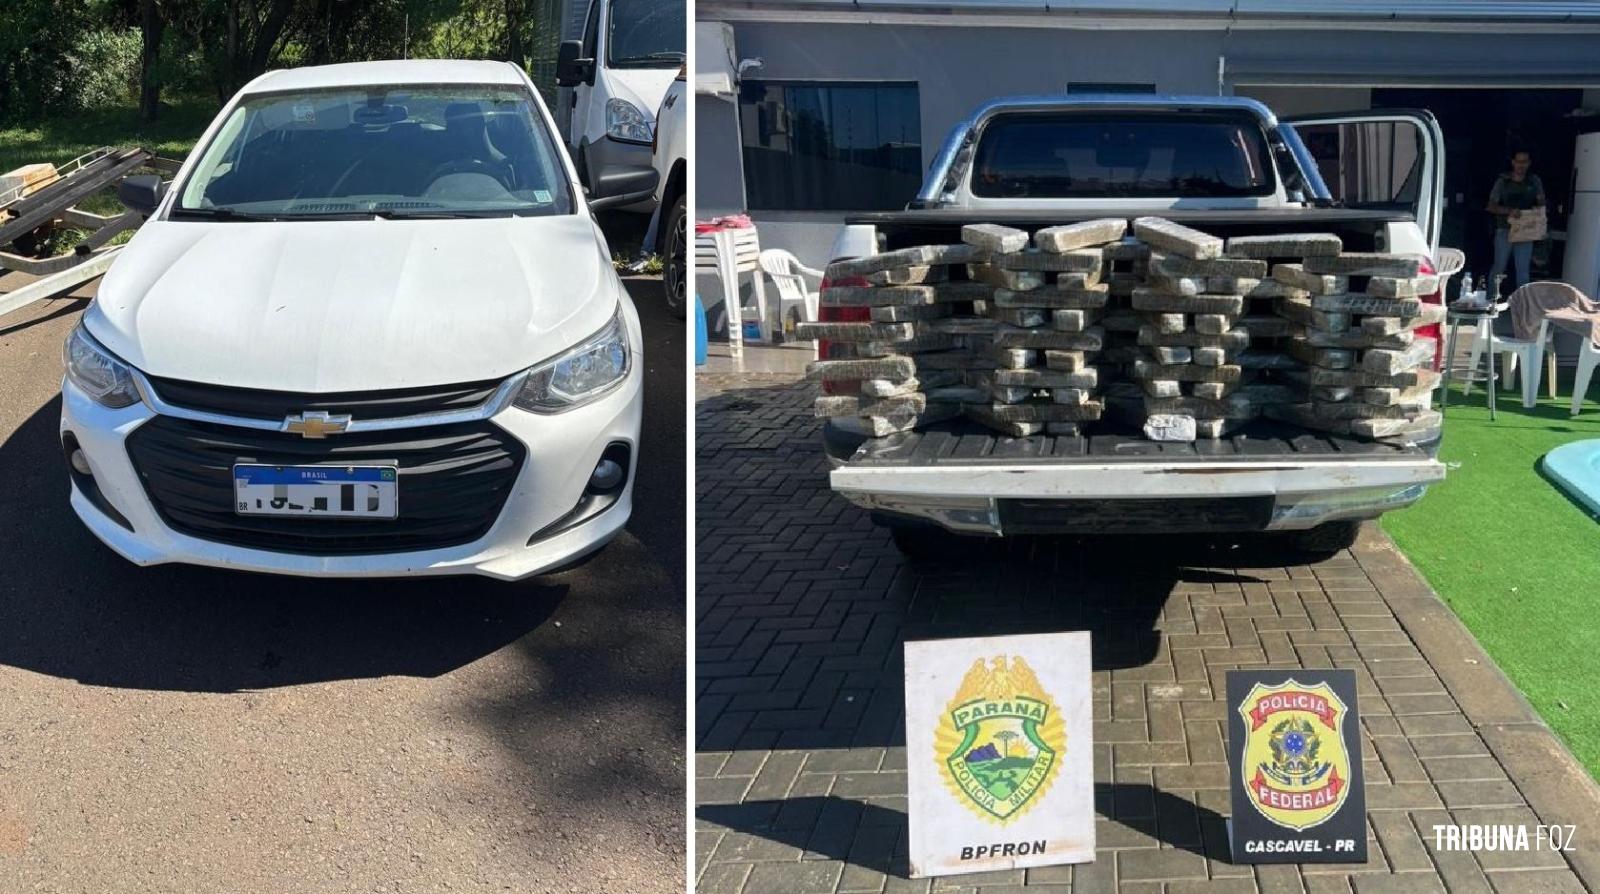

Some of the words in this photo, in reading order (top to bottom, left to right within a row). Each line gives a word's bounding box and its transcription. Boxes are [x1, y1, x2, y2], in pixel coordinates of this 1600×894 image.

[301, 471, 328, 479] BRASIL
[238, 502, 248, 511] BR
[957, 702, 1043, 724] PARANÁ
[1010, 756, 1049, 806] MILITAR
[1259, 789, 1335, 809] FEDERAL
[960, 840, 1047, 860] BPFRON
[1245, 840, 1322, 853] CASCAVEL
[1335, 839, 1355, 853] PR
